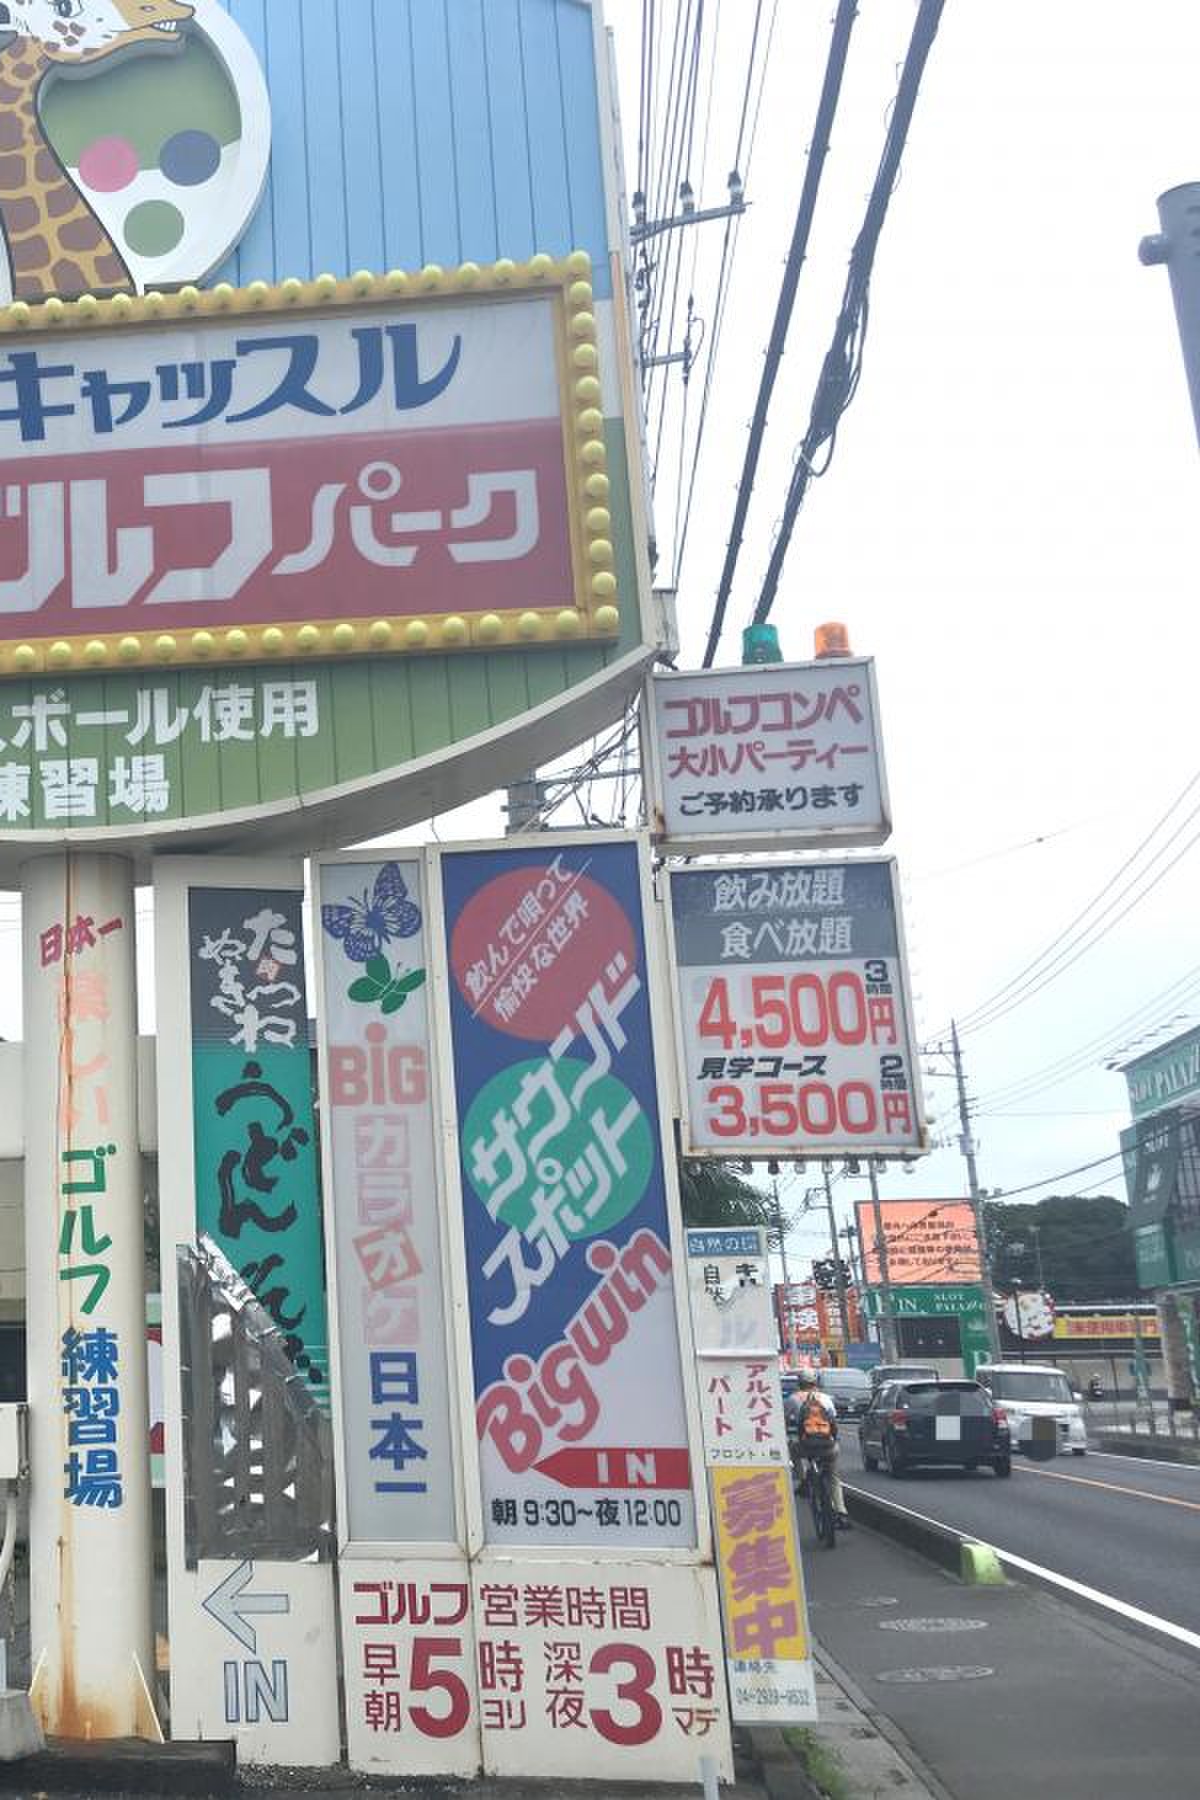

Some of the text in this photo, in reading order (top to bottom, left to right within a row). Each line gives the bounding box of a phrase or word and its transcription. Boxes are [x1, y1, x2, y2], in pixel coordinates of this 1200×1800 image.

[663, 684, 864, 739] ゴルフコンペ
[668, 738, 869, 779] 大小パーティー
[679, 782, 865, 817] ご予約承ります
[713, 867, 845, 913] 飲み放題
[39, 914, 123, 968] 日本一
[465, 852, 574, 1001] 飲んで唄って
[494, 889, 593, 1023] 愉快な世界
[720, 915, 854, 960] 食べ放題
[471, 951, 641, 1220] サウンド
[696, 1054, 828, 1081] 見学コース
[481, 1096, 641, 1326] スポット
[368, 1351, 429, 1494] 日本一
[707, 1376, 733, 1437] パート
[745, 1364, 774, 1443] アルバイト
[596, 1452, 658, 1484] IN
[720, 1471, 799, 1659] 募集中
[353, 1582, 652, 1631] ゴルフ 営業時間
[224, 1660, 289, 1723] IN
[363, 1642, 400, 1733] 早朝
[543, 1642, 588, 1729] 深夜
